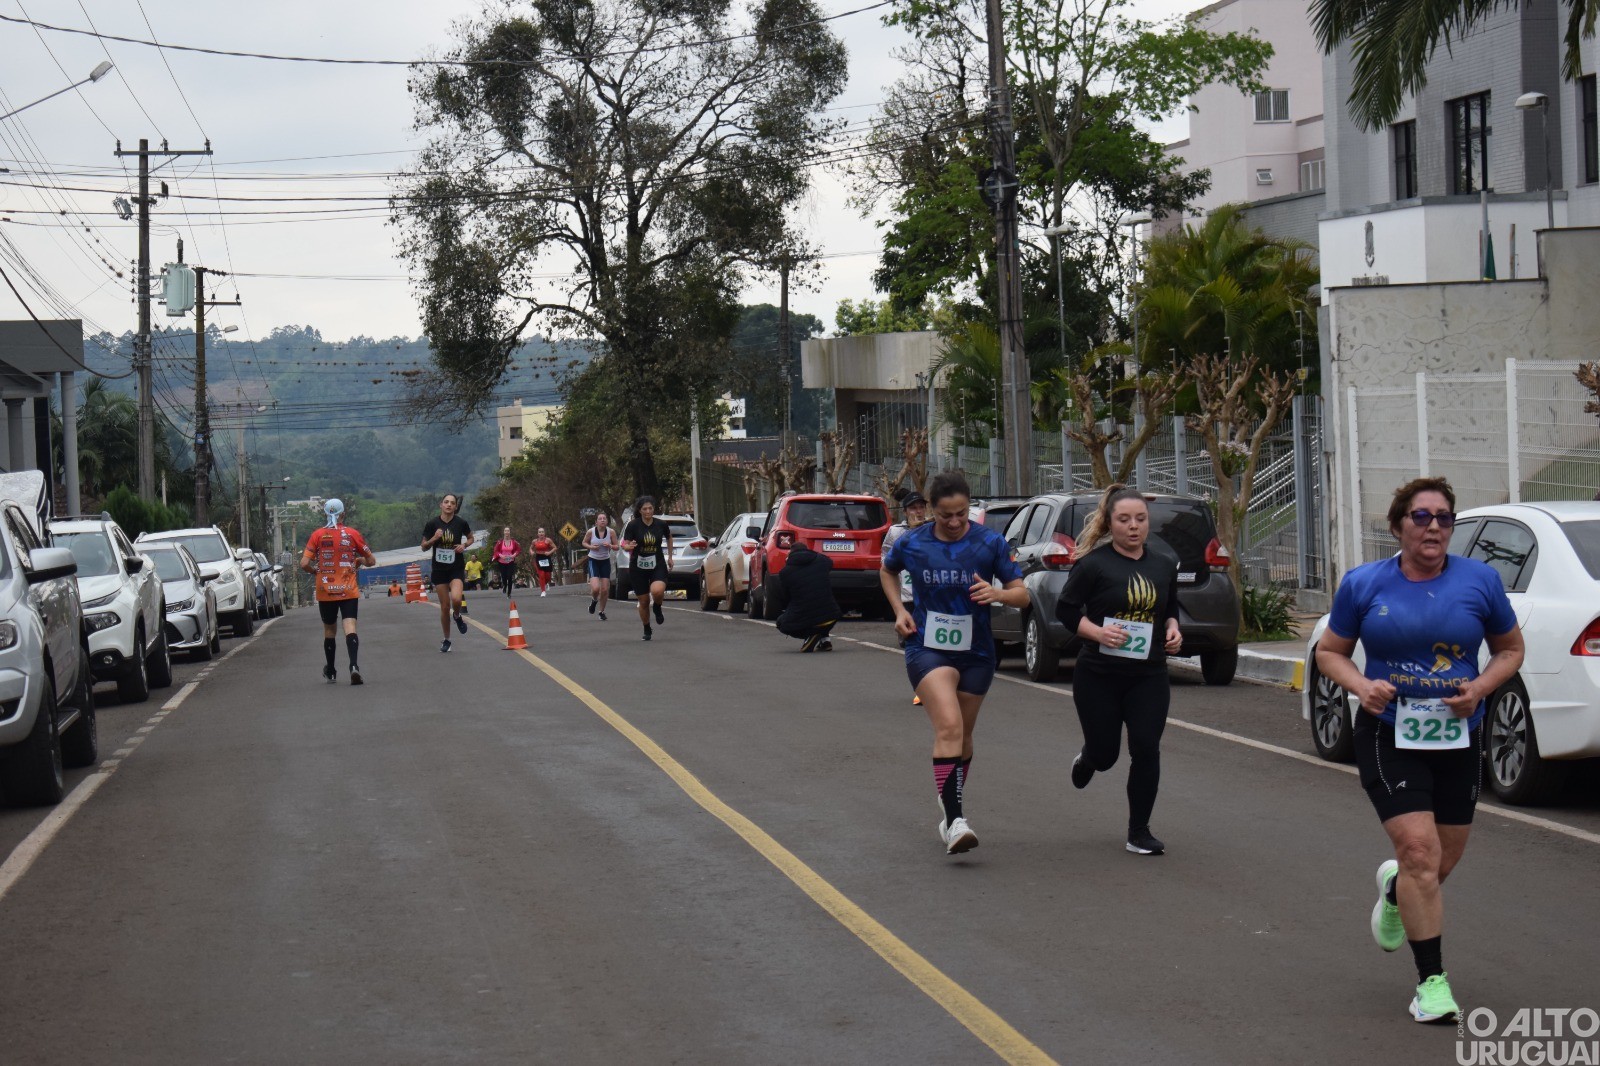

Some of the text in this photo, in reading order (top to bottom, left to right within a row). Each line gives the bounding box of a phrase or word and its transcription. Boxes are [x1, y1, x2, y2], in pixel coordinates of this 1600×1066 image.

[437, 554, 453, 562] 151
[935, 627, 962, 645] 60
[1402, 717, 1462, 742] 325
